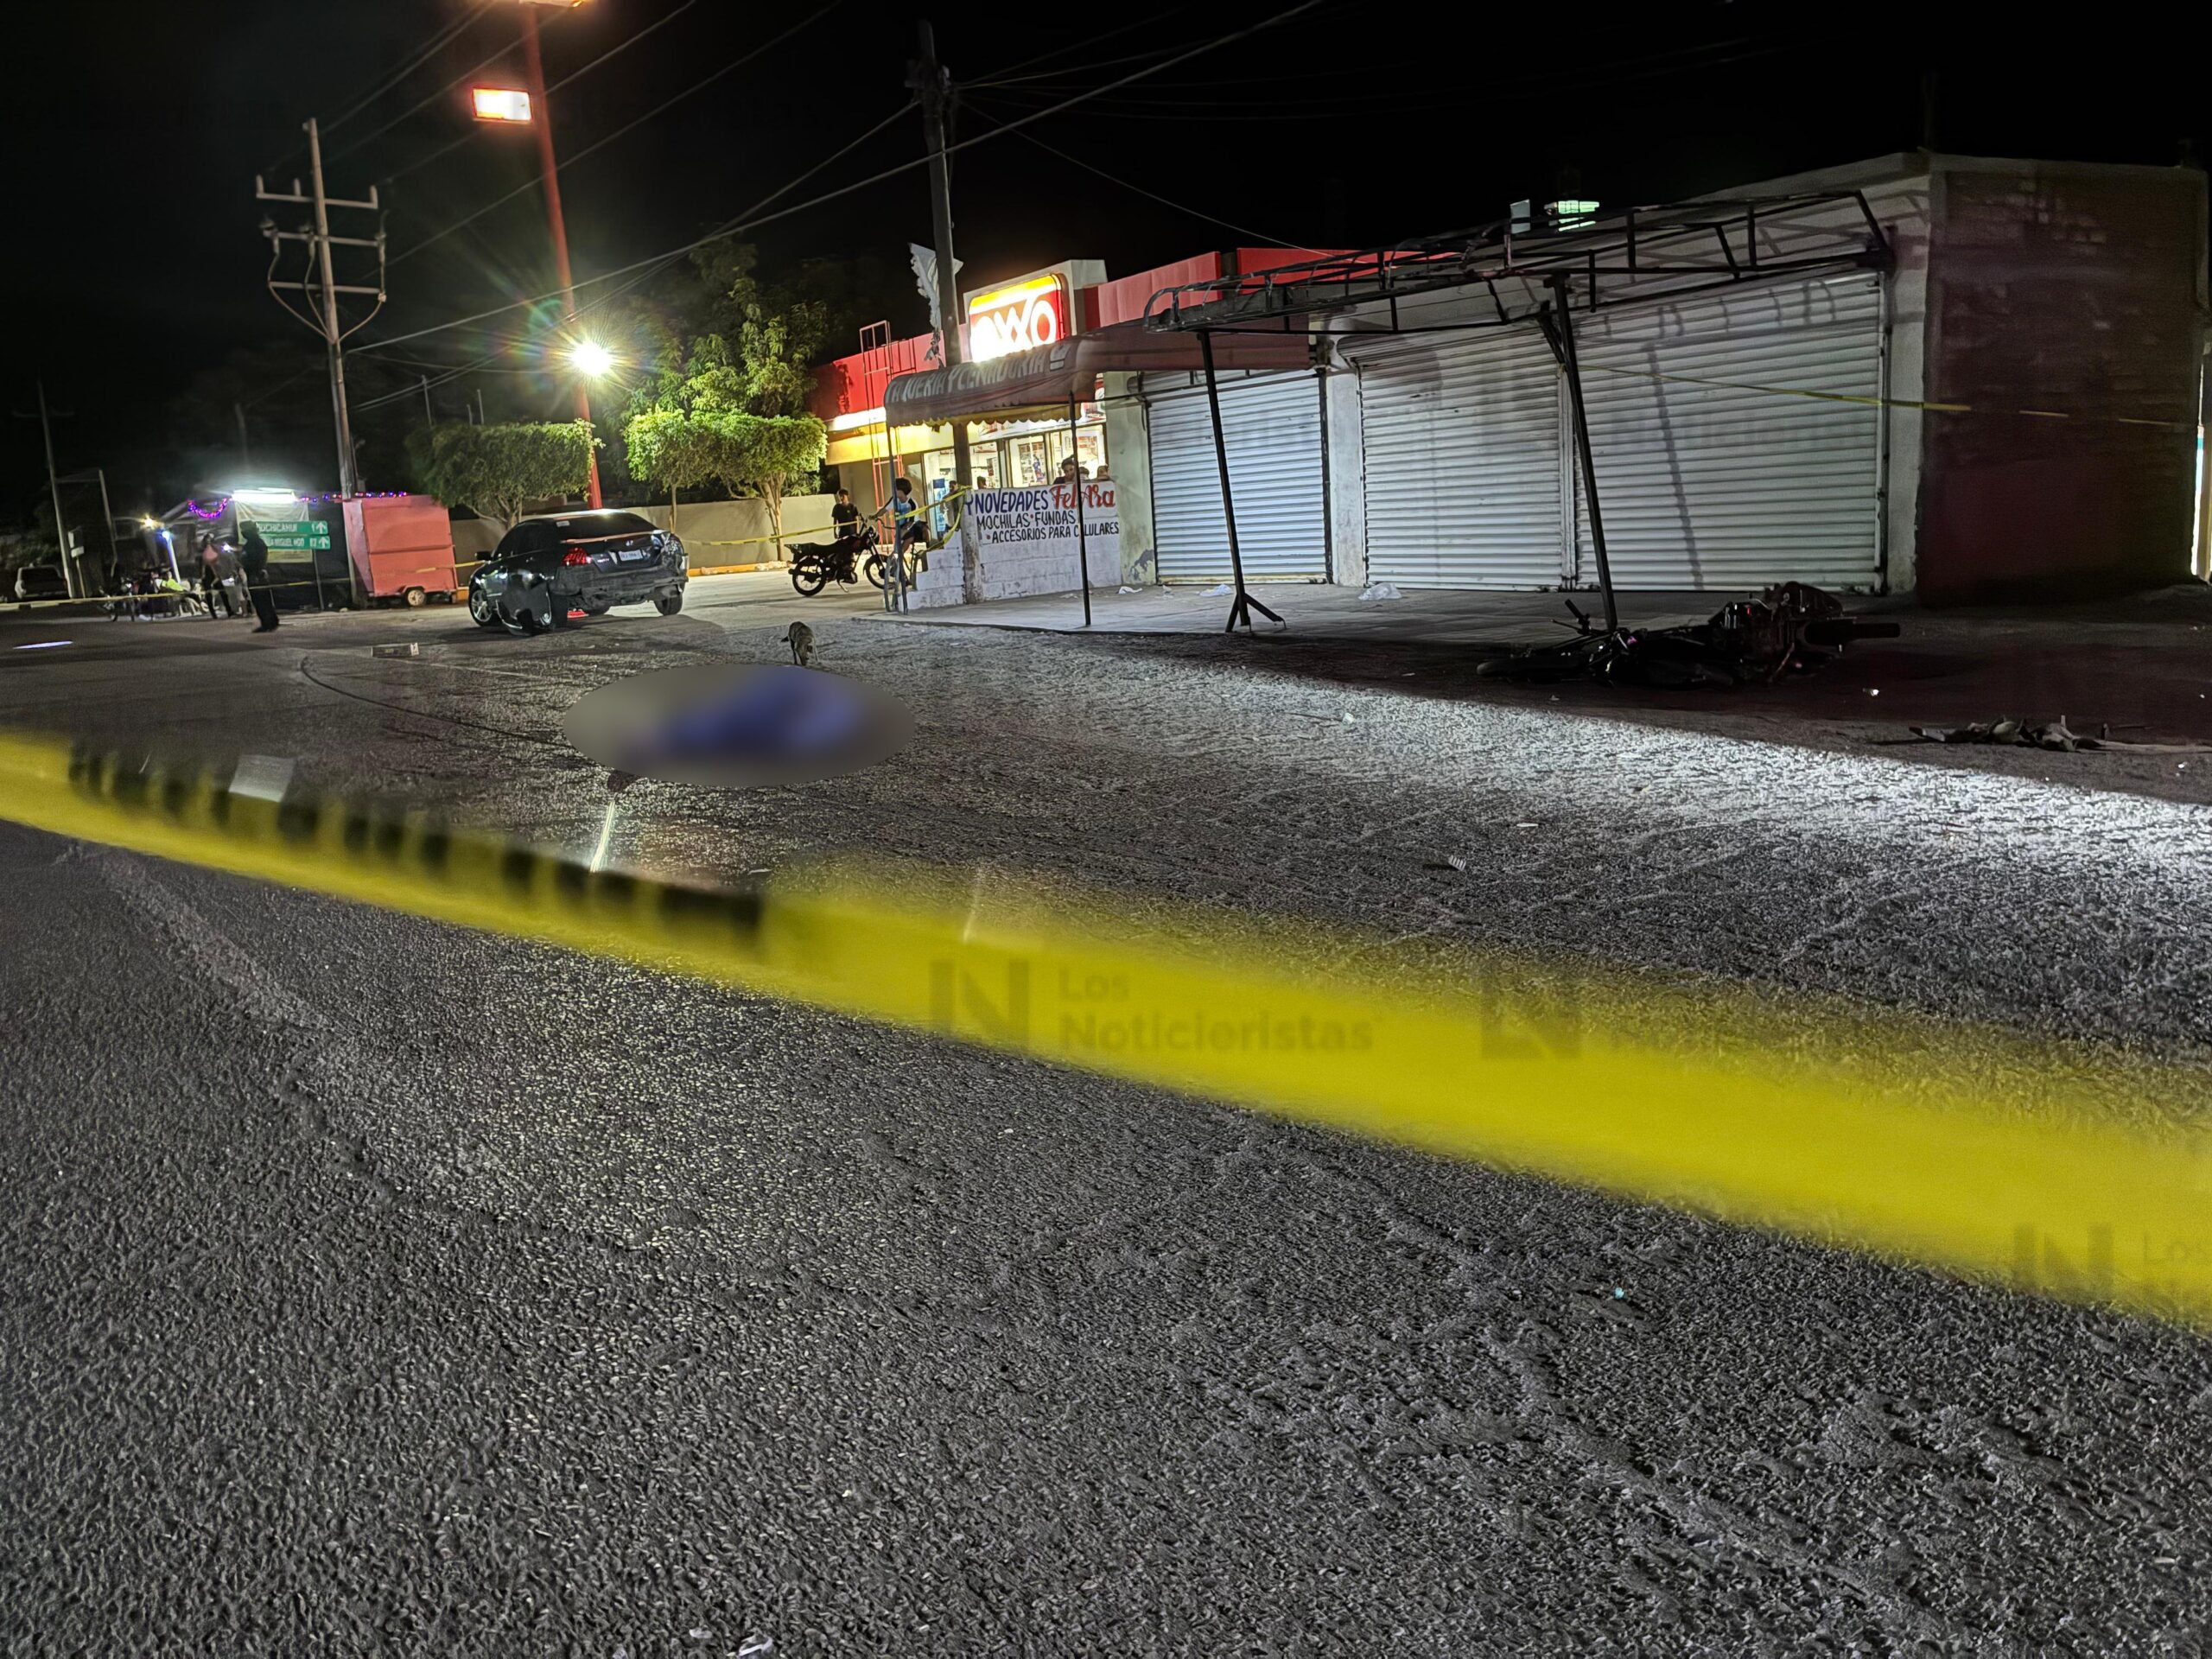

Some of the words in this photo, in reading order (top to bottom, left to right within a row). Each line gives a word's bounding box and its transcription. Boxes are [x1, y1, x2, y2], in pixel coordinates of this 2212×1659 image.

[976, 489, 1049, 514] NOVEDADES
[977, 513, 1030, 531] MOCHILAS
[1035, 510, 1077, 527] FUNDAS
[992, 527, 1046, 543] ACCESORIOS
[1048, 524, 1071, 539] PARA
[1074, 522, 1120, 537] CLULARES
